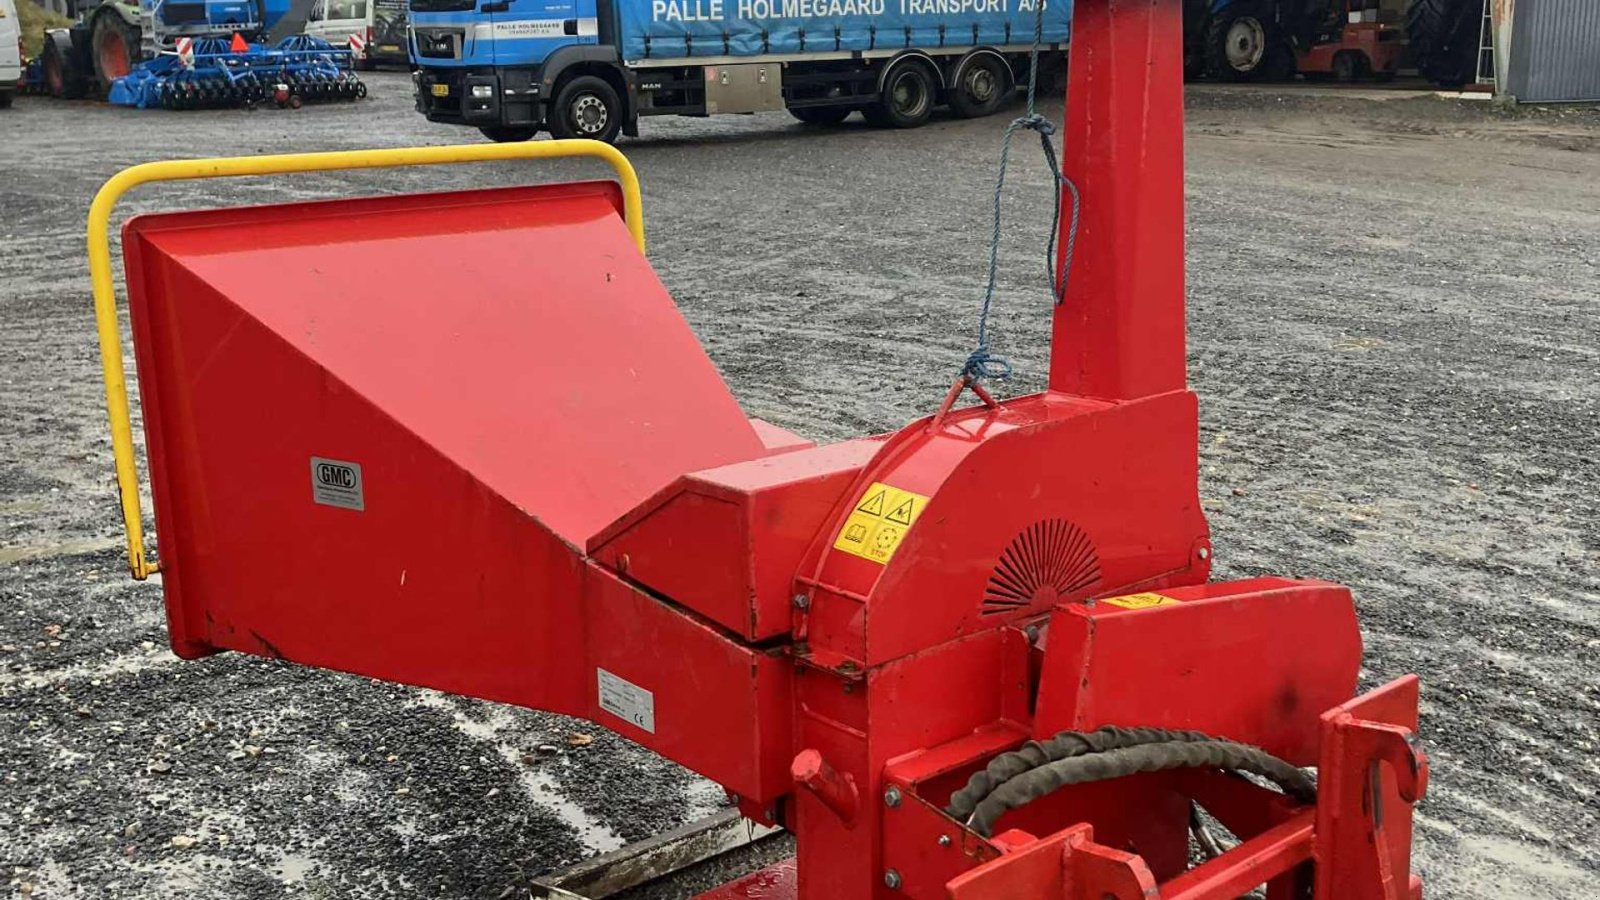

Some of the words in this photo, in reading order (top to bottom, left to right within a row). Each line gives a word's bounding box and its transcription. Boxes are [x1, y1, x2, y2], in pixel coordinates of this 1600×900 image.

[652, 0, 724, 21] PALLE
[737, 0, 886, 20] HOLMEGAARD
[899, 0, 1009, 15] TRANSPORT
[321, 465, 351, 486] GMC
